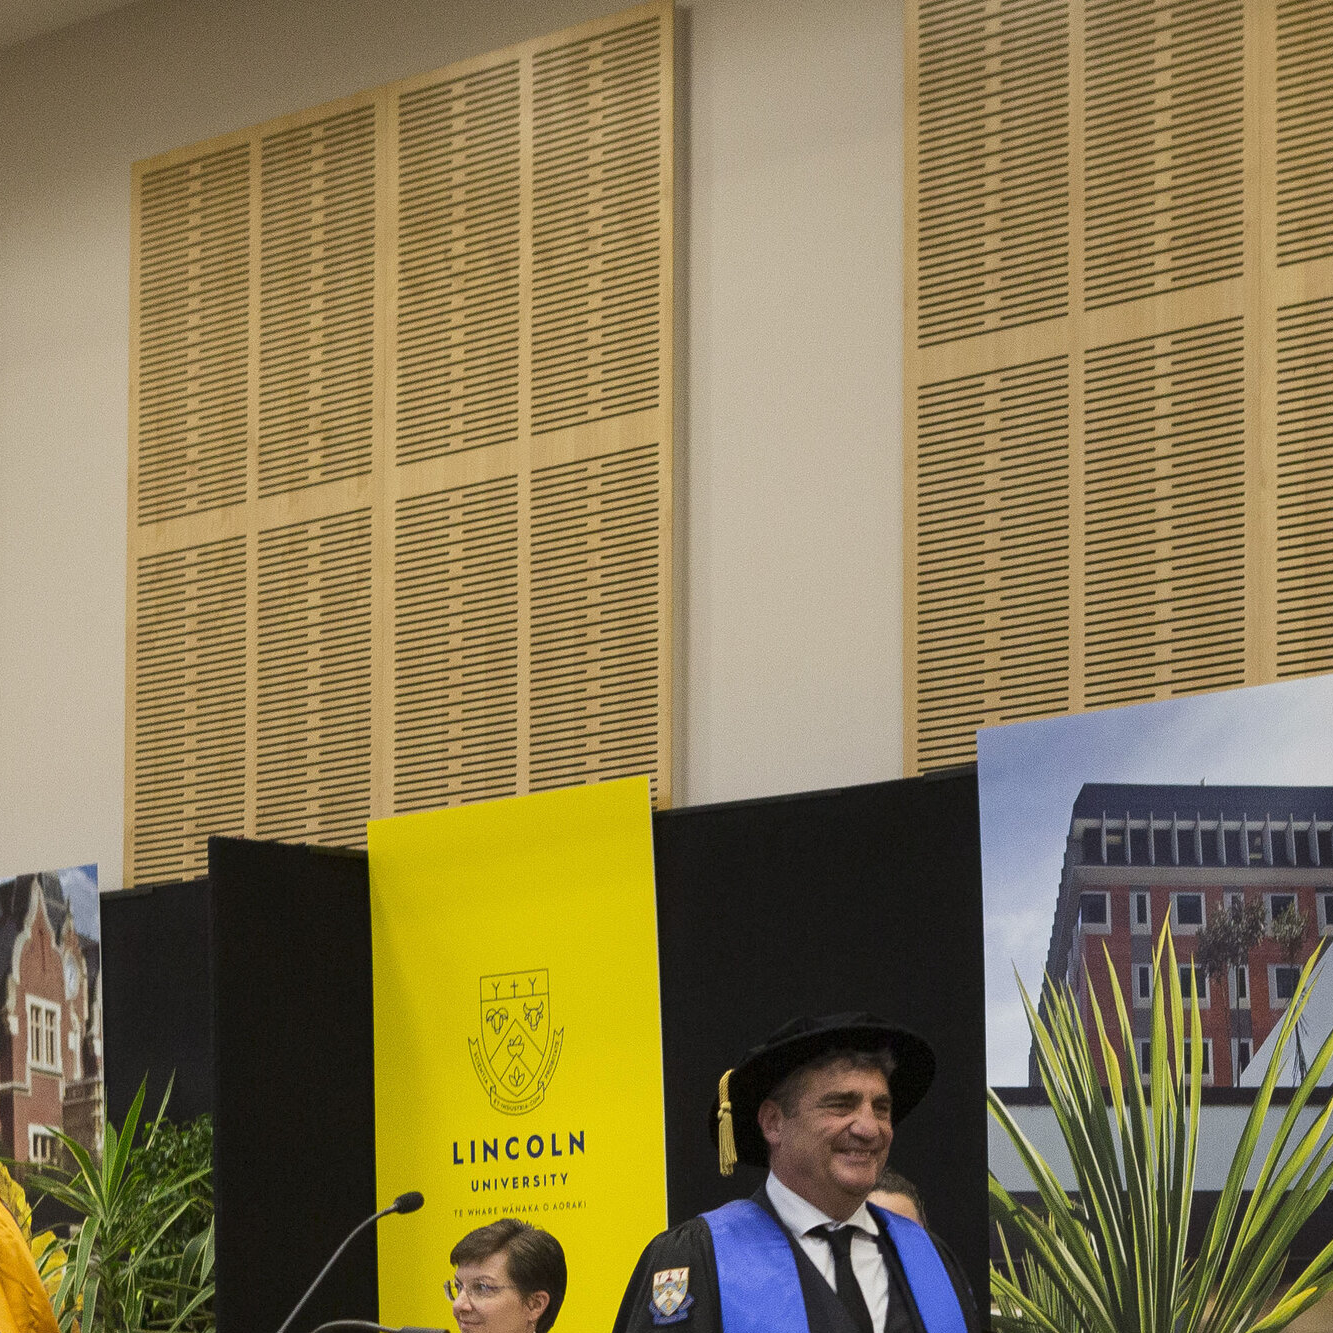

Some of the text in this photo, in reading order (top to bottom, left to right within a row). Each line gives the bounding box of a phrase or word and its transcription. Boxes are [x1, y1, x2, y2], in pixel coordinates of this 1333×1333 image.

[453, 1131, 586, 1166] LINCOLN
[472, 1173, 569, 1193] UNIVERSITY
[454, 1209, 463, 1217] TE
[468, 1206, 498, 1217] WHARE
[543, 1203, 549, 1211] O
[553, 1200, 587, 1210] AORAKI
